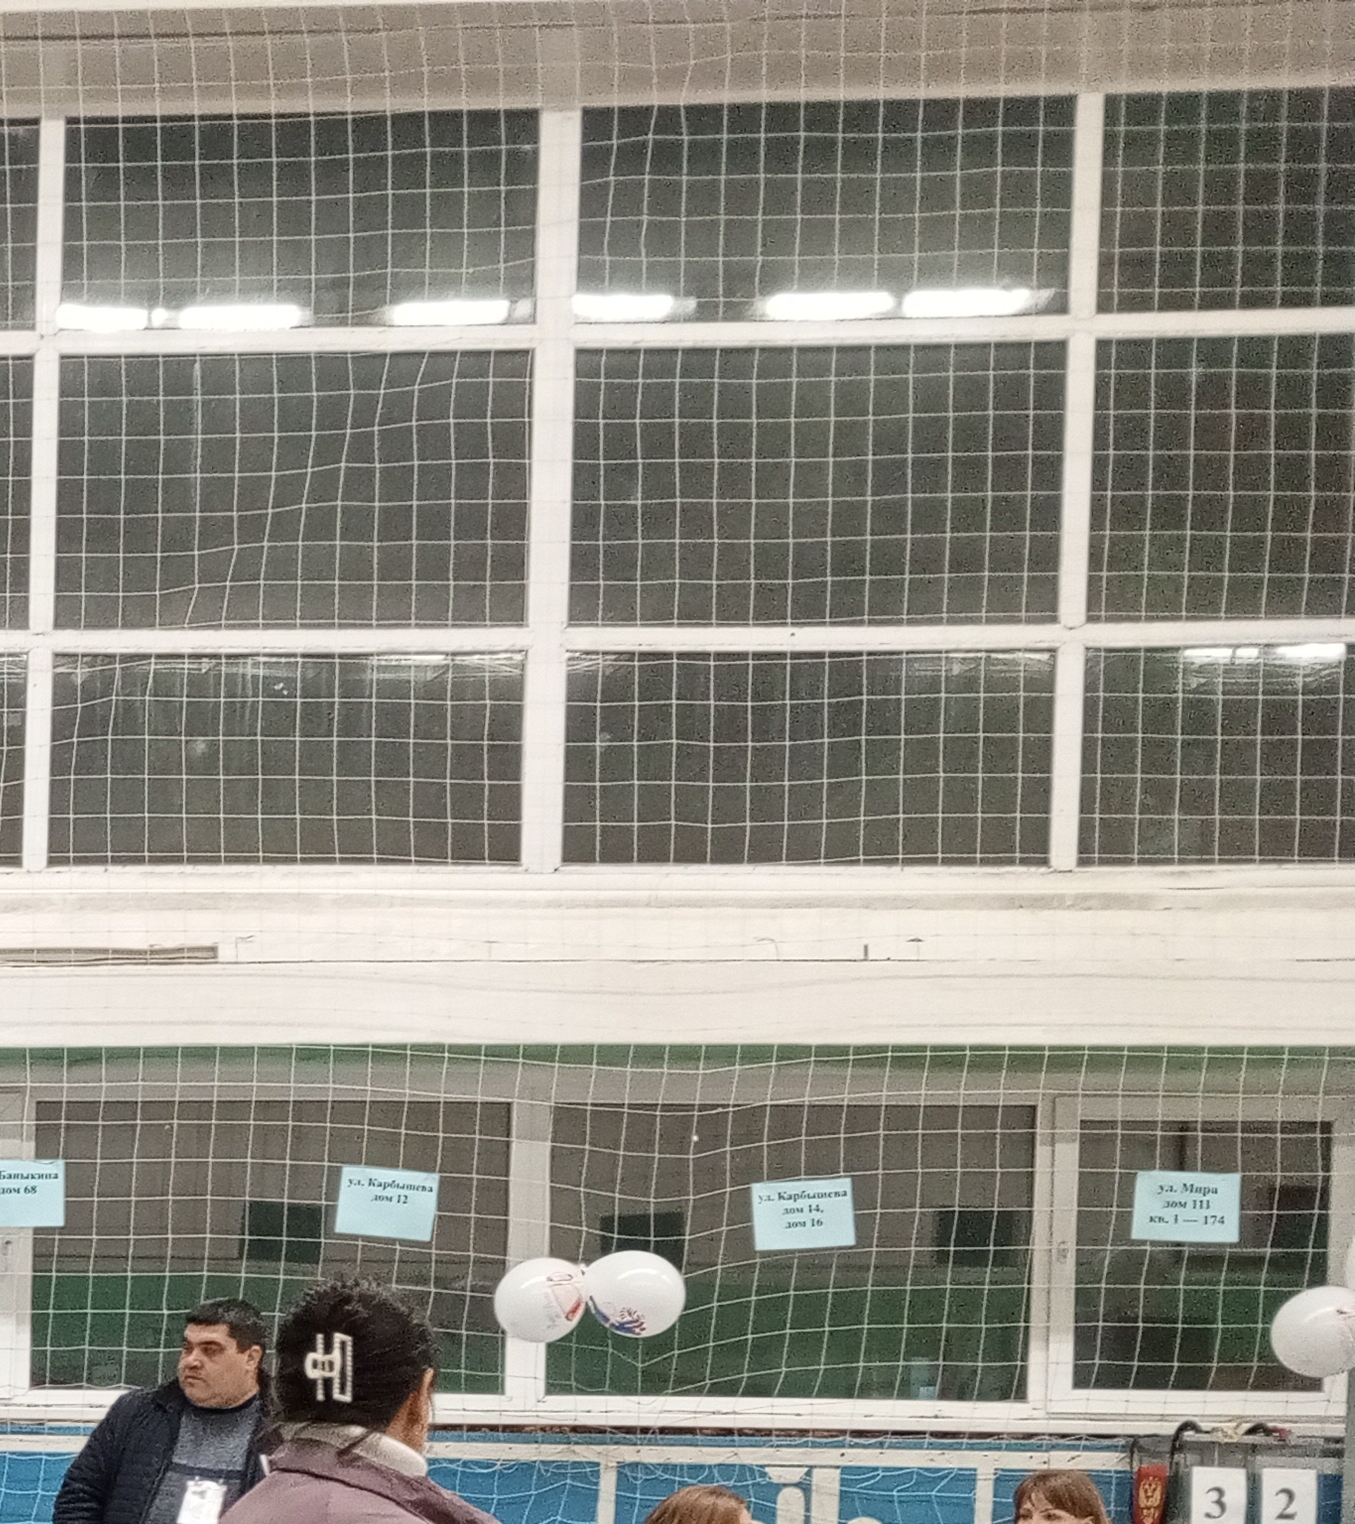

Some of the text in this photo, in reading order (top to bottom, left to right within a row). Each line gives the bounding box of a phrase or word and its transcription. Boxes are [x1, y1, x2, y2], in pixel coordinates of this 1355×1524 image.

[23, 1185, 38, 1195] 68
[347, 1177, 434, 1193] ул. Карбышева
[1157, 1183, 1219, 1197] ул. Мира
[370, 1194, 409, 1205] дом 12
[758, 1190, 848, 1204] ул. Карбышева
[1162, 1199, 1211, 1210] дом 111
[782, 1206, 804, 1216] дом
[784, 1218, 824, 1229] дом 16
[1149, 1215, 1169, 1224] кв.
[1173, 1214, 1179, 1224] 1
[1203, 1215, 1226, 1226] 174
[1204, 1486, 1298, 1521] 3 2
